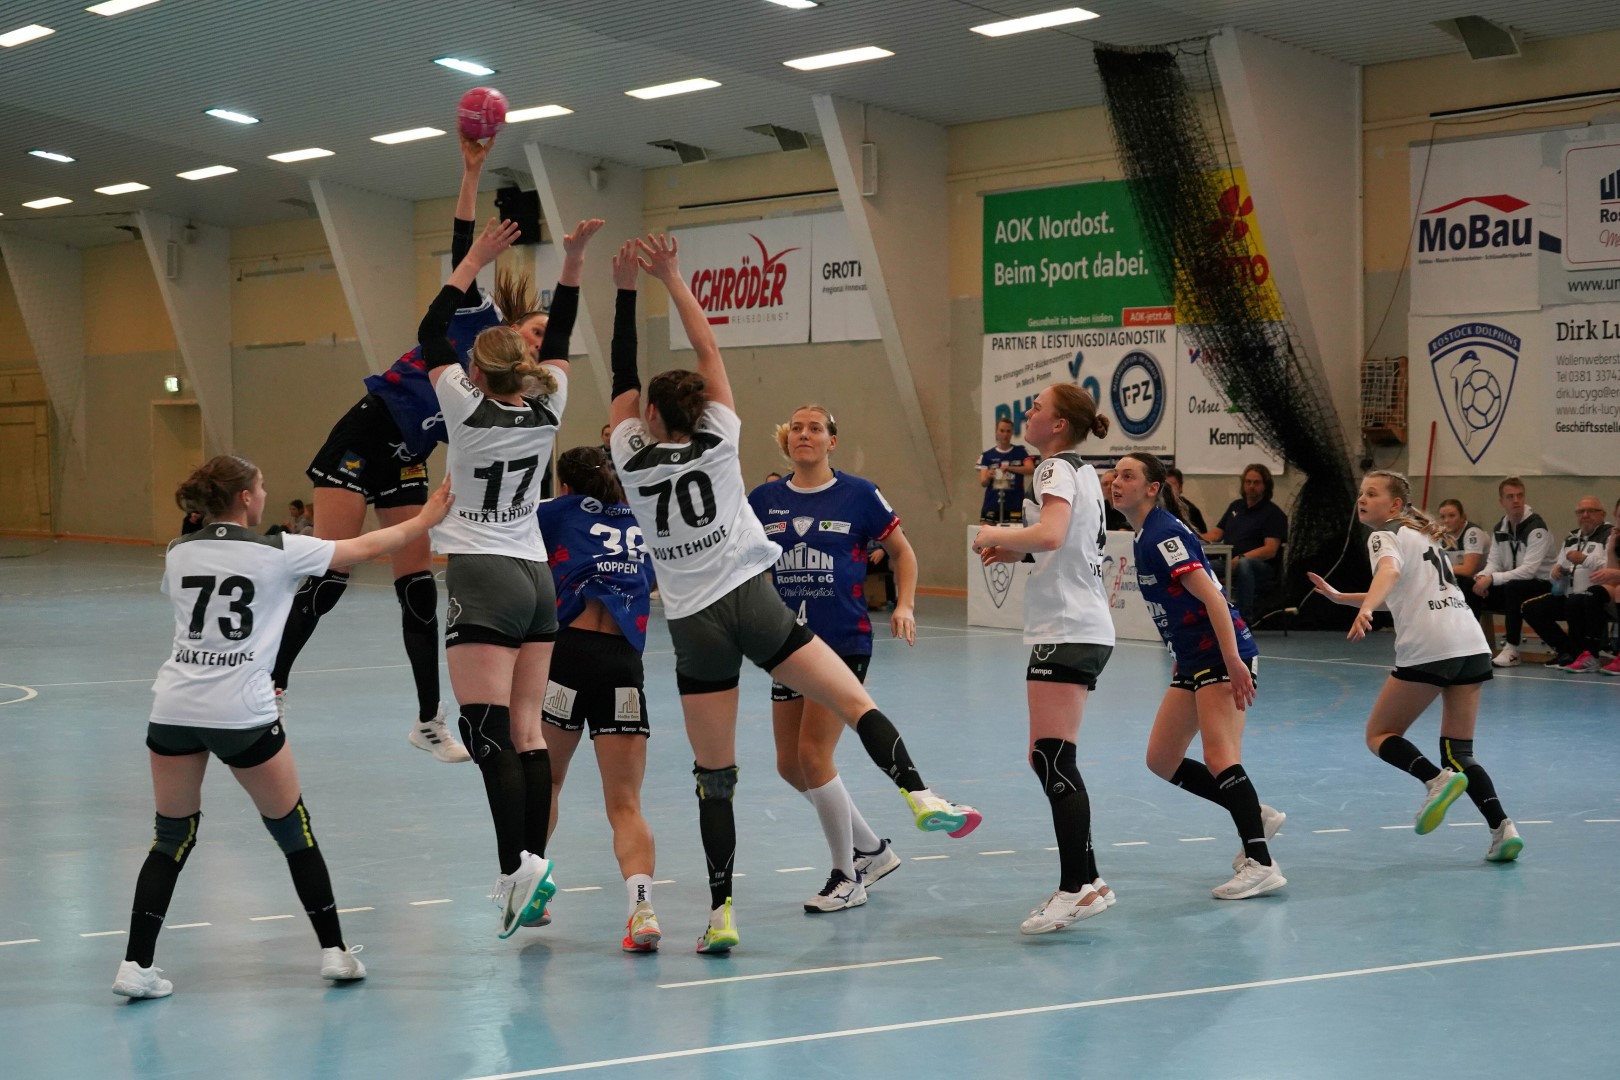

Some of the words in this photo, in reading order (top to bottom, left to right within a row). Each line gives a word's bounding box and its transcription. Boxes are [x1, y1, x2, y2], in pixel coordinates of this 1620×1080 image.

[994, 217, 1034, 244] AOK
[1039, 210, 1115, 240] Nordost.
[1418, 214, 1532, 252] MoBau
[994, 259, 1036, 286] Beim
[1040, 256, 1089, 288] Sport
[1093, 249, 1149, 278] dabei.
[691, 255, 787, 312] SCHRÖDER
[731, 311, 789, 324] REISEDIENST
[1555, 319, 1599, 341] Dirk
[992, 335, 1037, 350] PARTNER
[1041, 329, 1166, 349] LEISTUNGSDIAGNOSTIK
[1431, 326, 1473, 351] ROSTOCK
[1475, 325, 1518, 348] DOLPHINS
[1568, 370, 1591, 382] 0381
[1122, 380, 1152, 406] FPZ
[1209, 427, 1254, 449] Kempa
[473, 454, 538, 512] 17
[638, 470, 717, 538] 70
[768, 508, 790, 516] Kempa
[652, 525, 728, 561] BUXTEHUDE
[596, 561, 638, 574] KOPPEN
[777, 573, 814, 584] Rostock
[818, 573, 834, 583] eG
[181, 575, 256, 641] 73
[1030, 666, 1052, 676] Kempa
